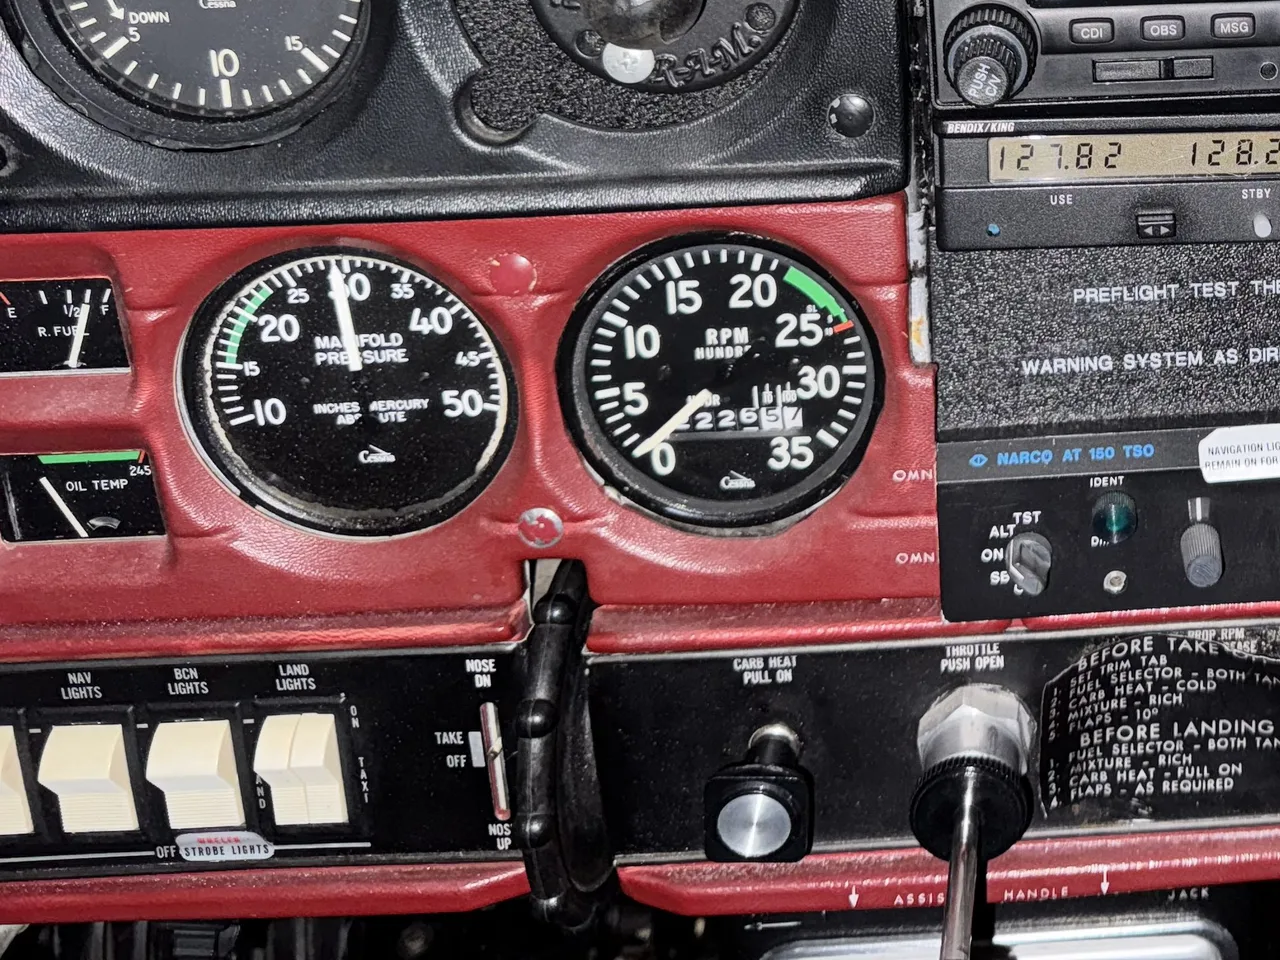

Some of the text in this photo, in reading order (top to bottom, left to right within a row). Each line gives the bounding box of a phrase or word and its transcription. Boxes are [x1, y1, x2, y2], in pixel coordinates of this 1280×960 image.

[129, 10, 170, 25] DOWN
[1080, 27, 1104, 39] CDI
[1150, 24, 1178, 36] OBS
[1220, 22, 1249, 34] MSG
[946, 122, 1016, 134] BENDIX/KING
[998, 141, 1122, 172] 127.82
[1050, 193, 1073, 206] USE
[1241, 187, 1272, 200] STBY
[1073, 283, 1180, 303] PREFLIGHT
[1190, 280, 1240, 298] TEST
[408, 305, 454, 336] 40
[705, 326, 750, 346] RPM
[1021, 354, 1114, 376] WARNING
[1123, 350, 1203, 370] SYSTEM
[1213, 348, 1239, 365] AS
[313, 401, 361, 414] INCHES
[997, 443, 1155, 467] NARCO AT 150 TSO
[1207, 442, 1264, 456] NAVIGATION
[1204, 457, 1241, 470] REMAIN
[1244, 456, 1258, 468] ON
[1260, 454, 1279, 466] FOR
[129, 465, 151, 477] 245
[66, 478, 128, 492] OIL TEMP
[1089, 475, 1125, 488] IDENT
[1012, 510, 1042, 525] TST
[980, 548, 1004, 563] ON
[945, 642, 1001, 657] THROTTLE
[278, 663, 310, 677] LAND
[465, 659, 497, 674] NOSE
[733, 655, 798, 671] CARB HEAT
[940, 655, 1005, 673] PUSH OPEN
[67, 672, 92, 685] NAV
[173, 667, 199, 681] BCN
[742, 668, 793, 685] PULL ON
[1110, 667, 1183, 685] SELECTOR
[167, 681, 209, 695] LIGHTS
[275, 677, 317, 691] LIGHTS
[1176, 679, 1218, 692] COLD
[60, 686, 103, 700] LIGHTS
[434, 731, 464, 745] TAKE
[1080, 719, 1275, 747] BEFORE LANDING
[1112, 740, 1184, 756] SELECTOR
[1207, 737, 1247, 752] BOTH
[446, 754, 467, 769] OFF
[1162, 777, 1235, 794] REQUIRED
[487, 823, 513, 837] NOS
[156, 845, 177, 859] OFF
[184, 843, 270, 857] STROBE LIGHTS
[893, 892, 946, 906] ASSIS
[1003, 887, 1069, 901] HANDLE
